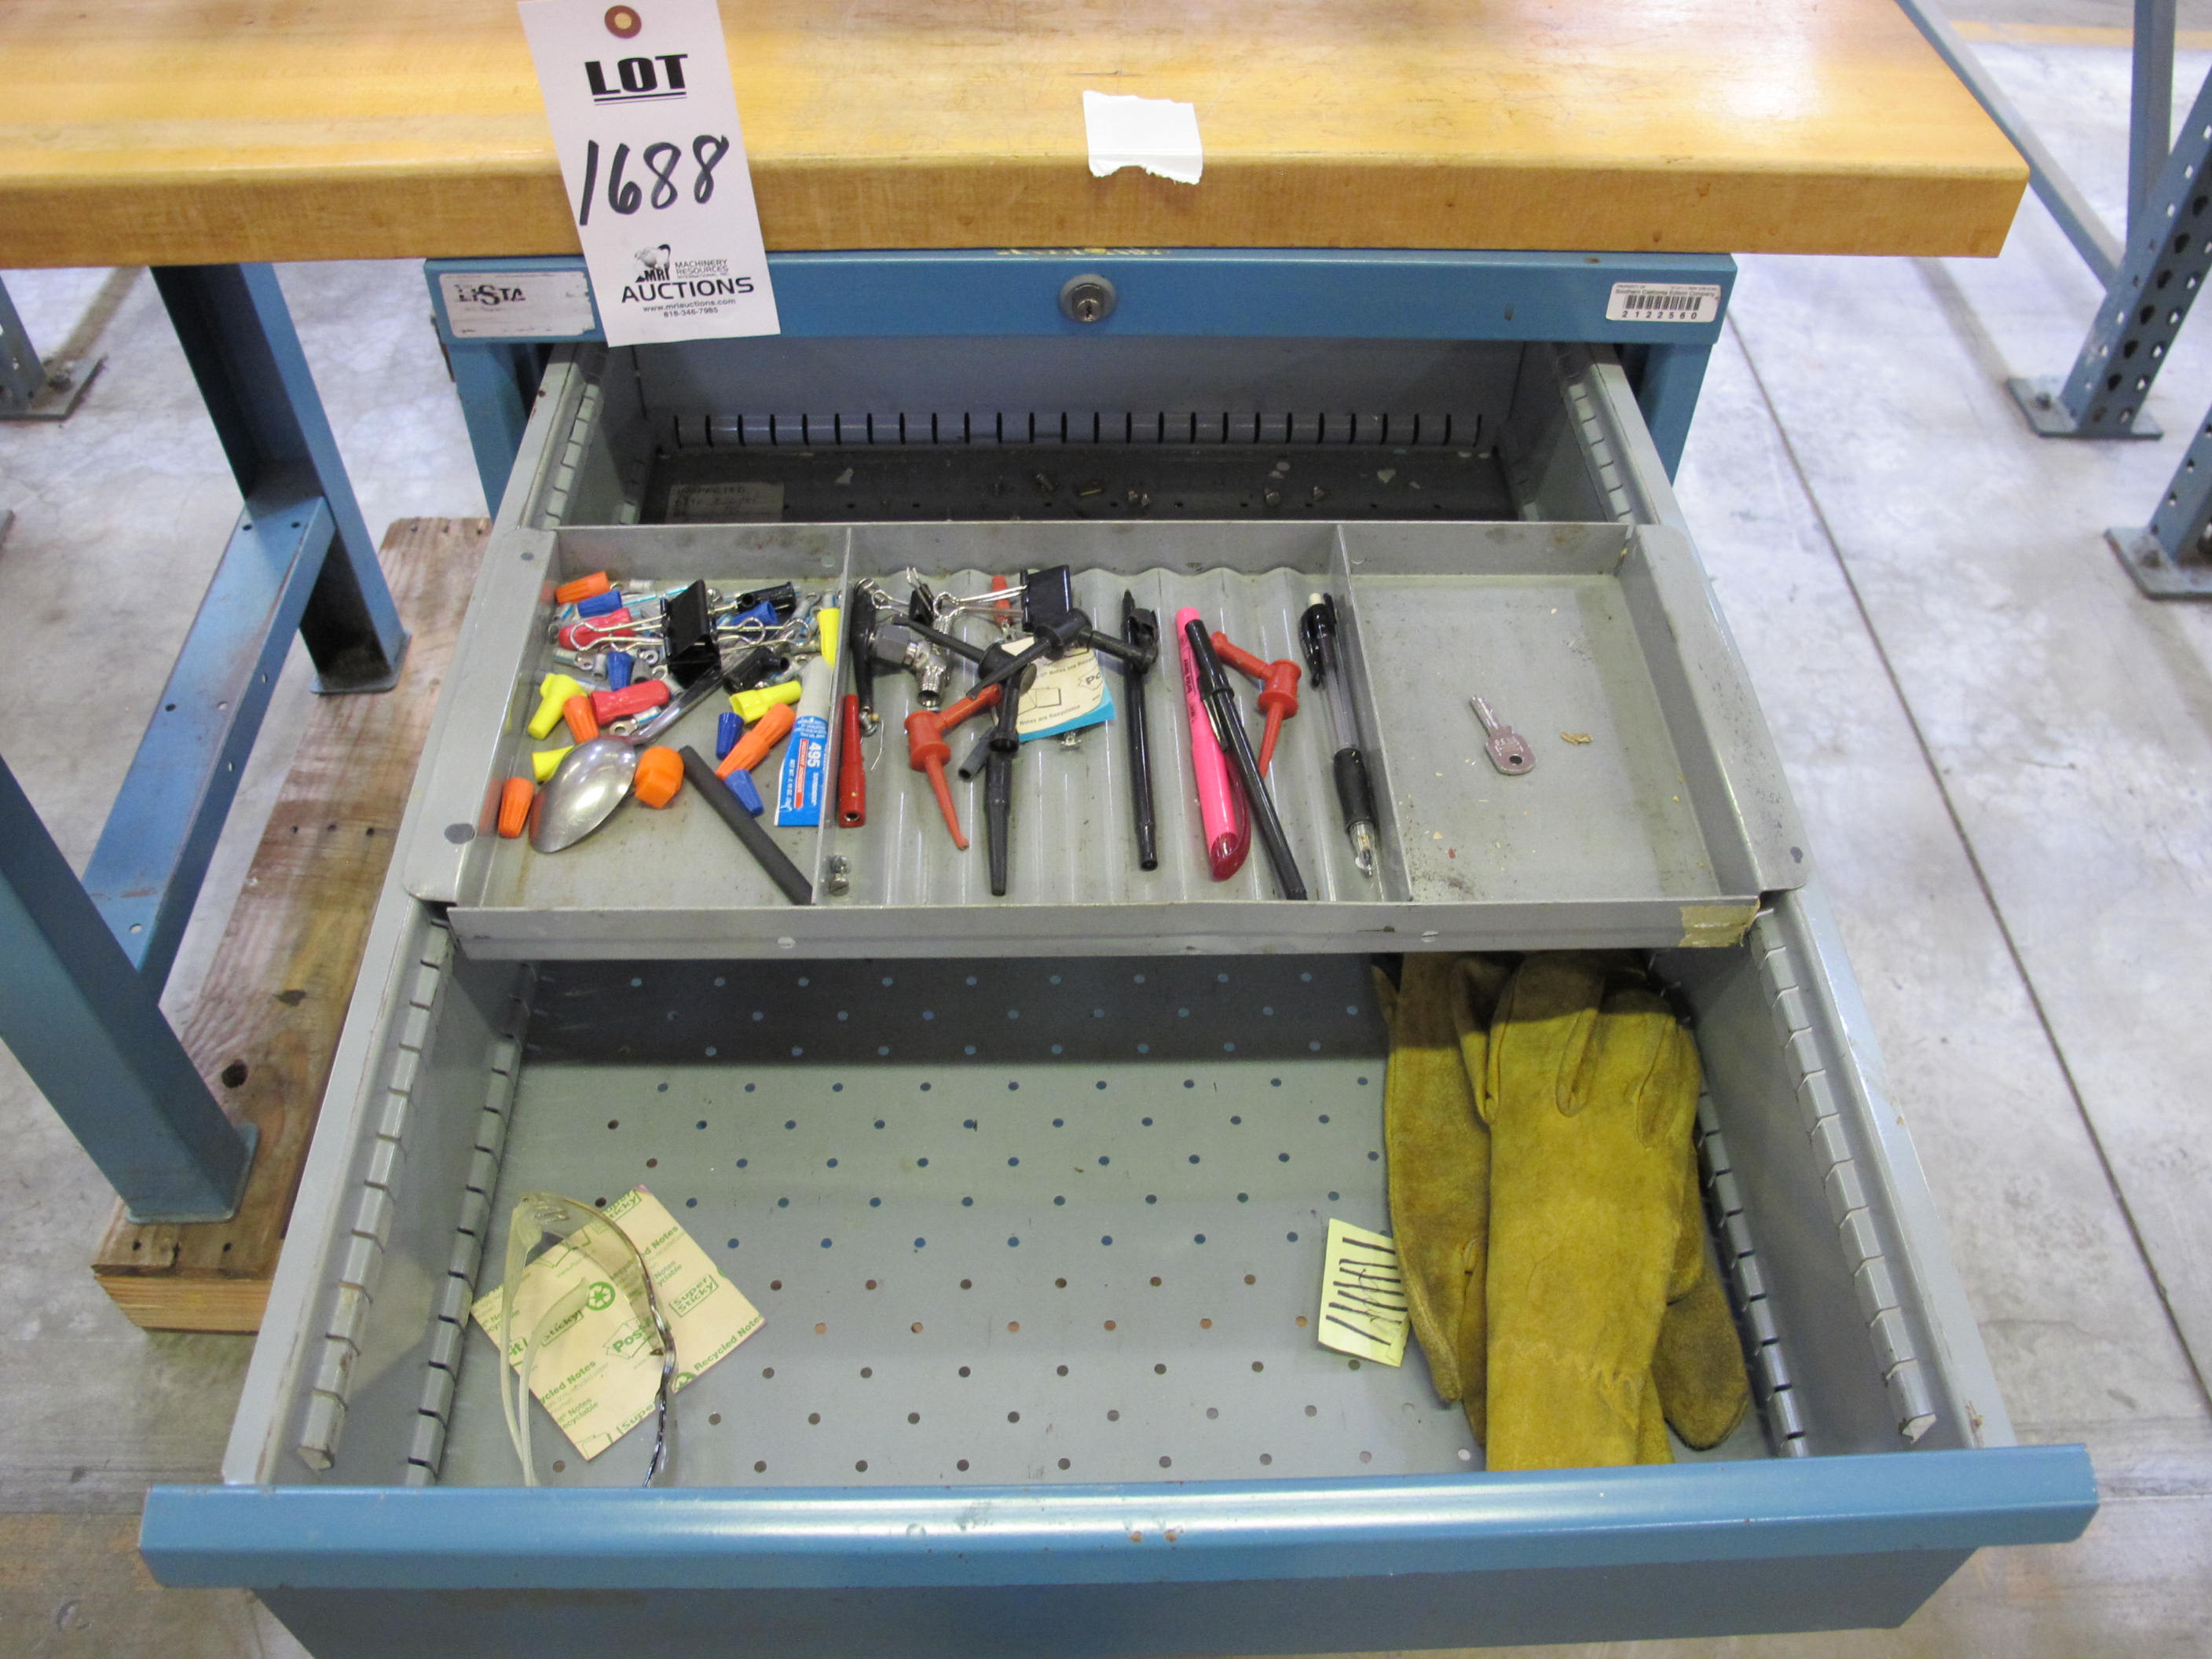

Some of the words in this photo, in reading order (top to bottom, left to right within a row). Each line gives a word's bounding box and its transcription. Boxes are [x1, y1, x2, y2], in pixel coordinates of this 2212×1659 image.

[584, 54, 688, 95] LOT
[579, 134, 730, 227] 1688
[645, 267, 670, 282] MRI
[675, 259, 728, 269] MACHINERY
[676, 266, 729, 275] RESOURCES
[621, 276, 754, 303] AUCTIONS
[808, 742, 822, 767] 495
[651, 1226, 679, 1248] Notes
[673, 1276, 708, 1306] Super
[678, 1281, 714, 1312] Sticky
[694, 1335, 737, 1371] Recycled
[566, 1361, 596, 1383] Notes
[568, 1397, 592, 1415] Notes
[621, 1403, 654, 1430] Supe
